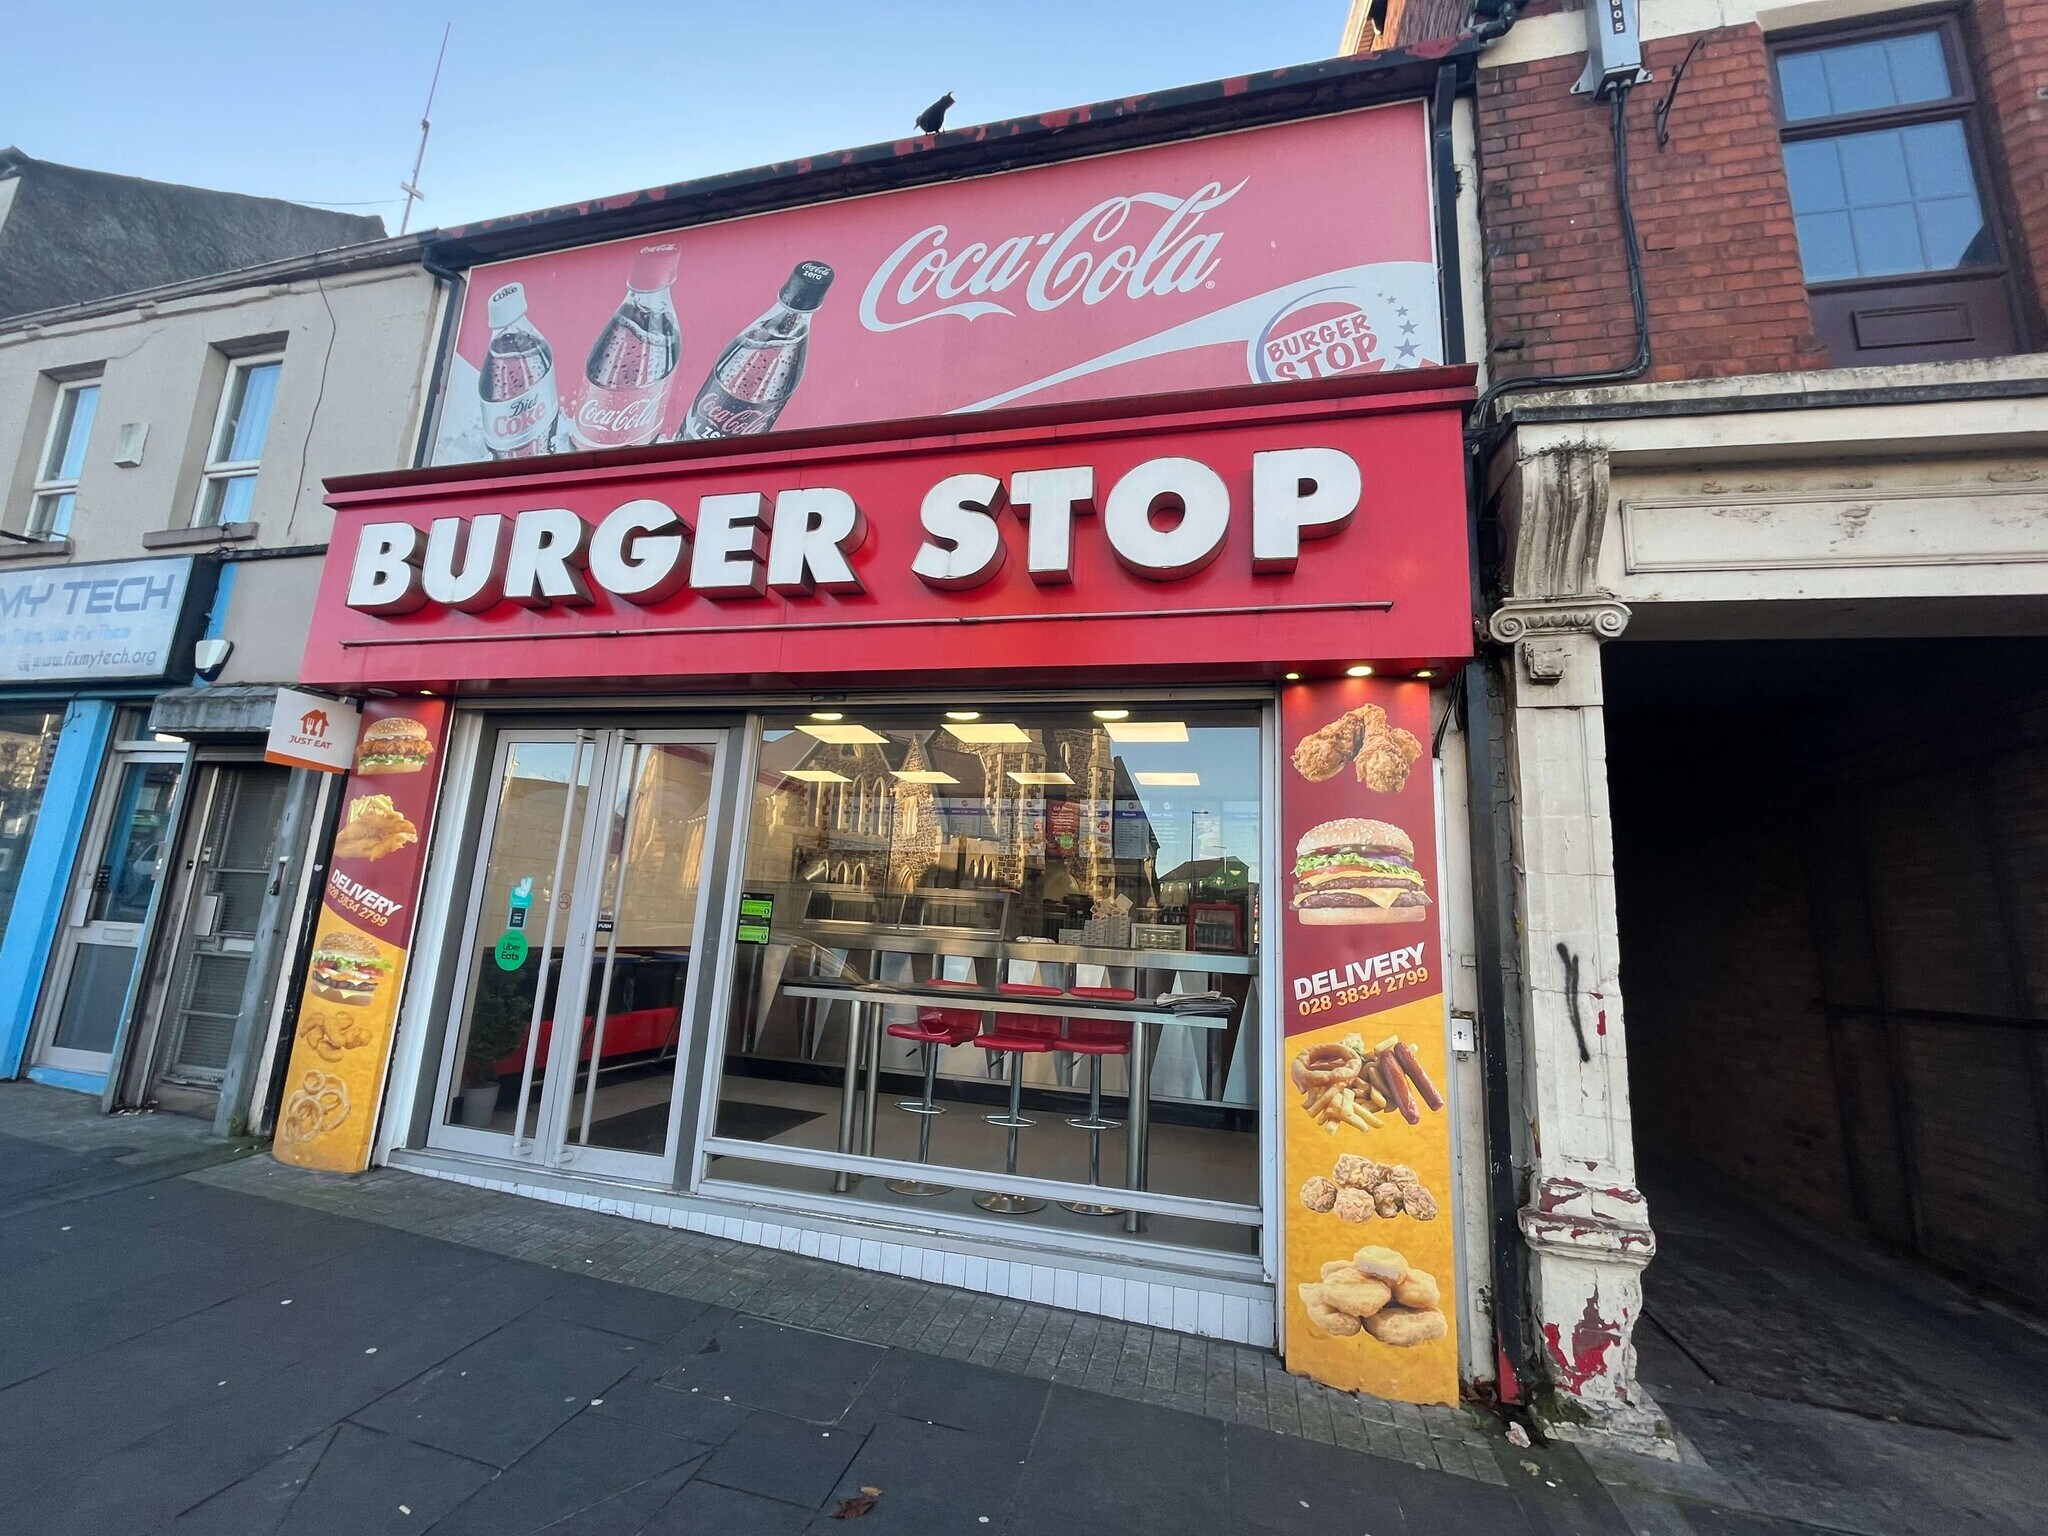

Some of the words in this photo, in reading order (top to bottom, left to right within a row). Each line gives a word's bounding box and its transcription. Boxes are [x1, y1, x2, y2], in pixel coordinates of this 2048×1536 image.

[859, 175, 1250, 333] Coca-Cola
[802, 270, 822, 280] zero
[492, 286, 518, 303] Coke
[1266, 314, 1371, 362] BURGER
[1275, 333, 1377, 380] STOP
[493, 402, 546, 438] Coke
[346, 487, 866, 612] BURGER
[911, 446, 1363, 590] STOP
[63, 574, 175, 615] TECH
[33, 647, 157, 669] www.fixmytech.org
[289, 735, 313, 746] JUST
[314, 740, 332, 749] EAT
[331, 868, 403, 916] DELIVERY
[338, 893, 360, 913] 3834
[358, 907, 388, 927] 2799
[501, 951, 519, 961] Eats
[502, 942, 521, 951] Uber
[1293, 941, 1425, 1001] DELIVERY
[1298, 995, 1332, 1016] 028
[1335, 980, 1381, 1006] 3834
[1384, 966, 1429, 992] 2799
